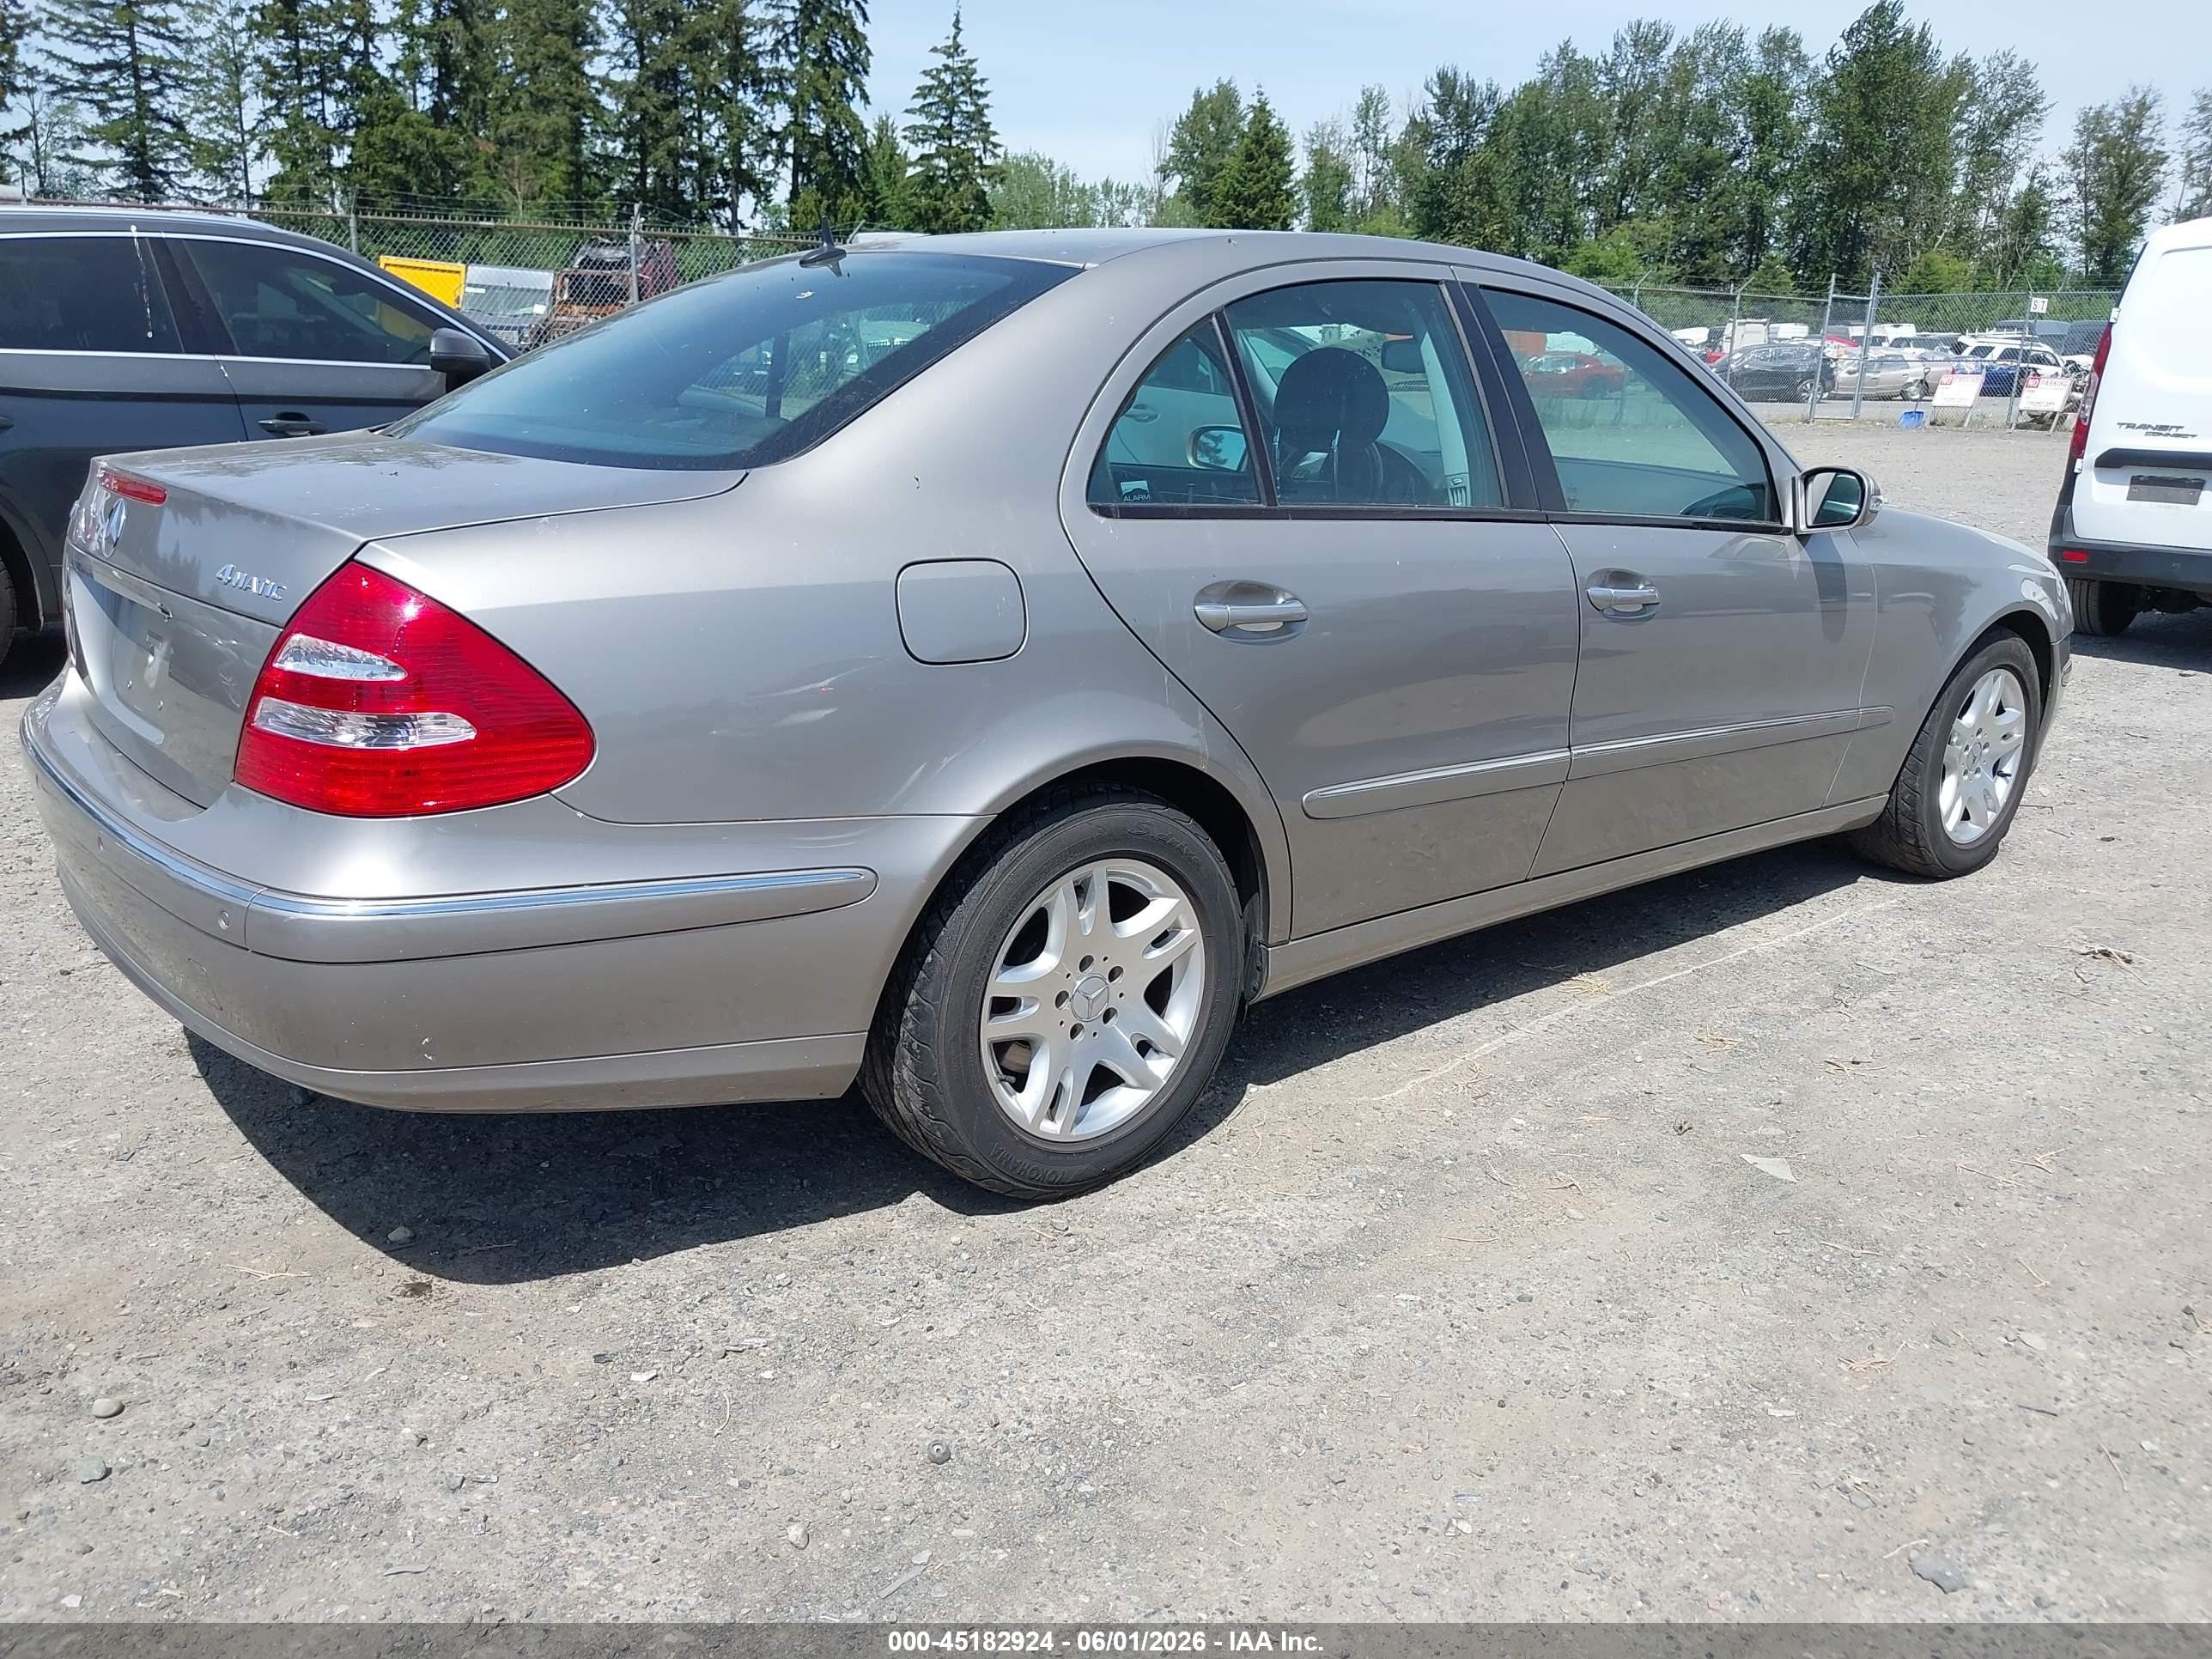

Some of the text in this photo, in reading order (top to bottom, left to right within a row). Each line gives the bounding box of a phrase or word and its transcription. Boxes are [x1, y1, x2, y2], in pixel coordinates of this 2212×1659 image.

[2117, 422, 2185, 433] TRANSIT
[1123, 494, 1151, 502] ALARM
[216, 563, 288, 601] 4MATIC
